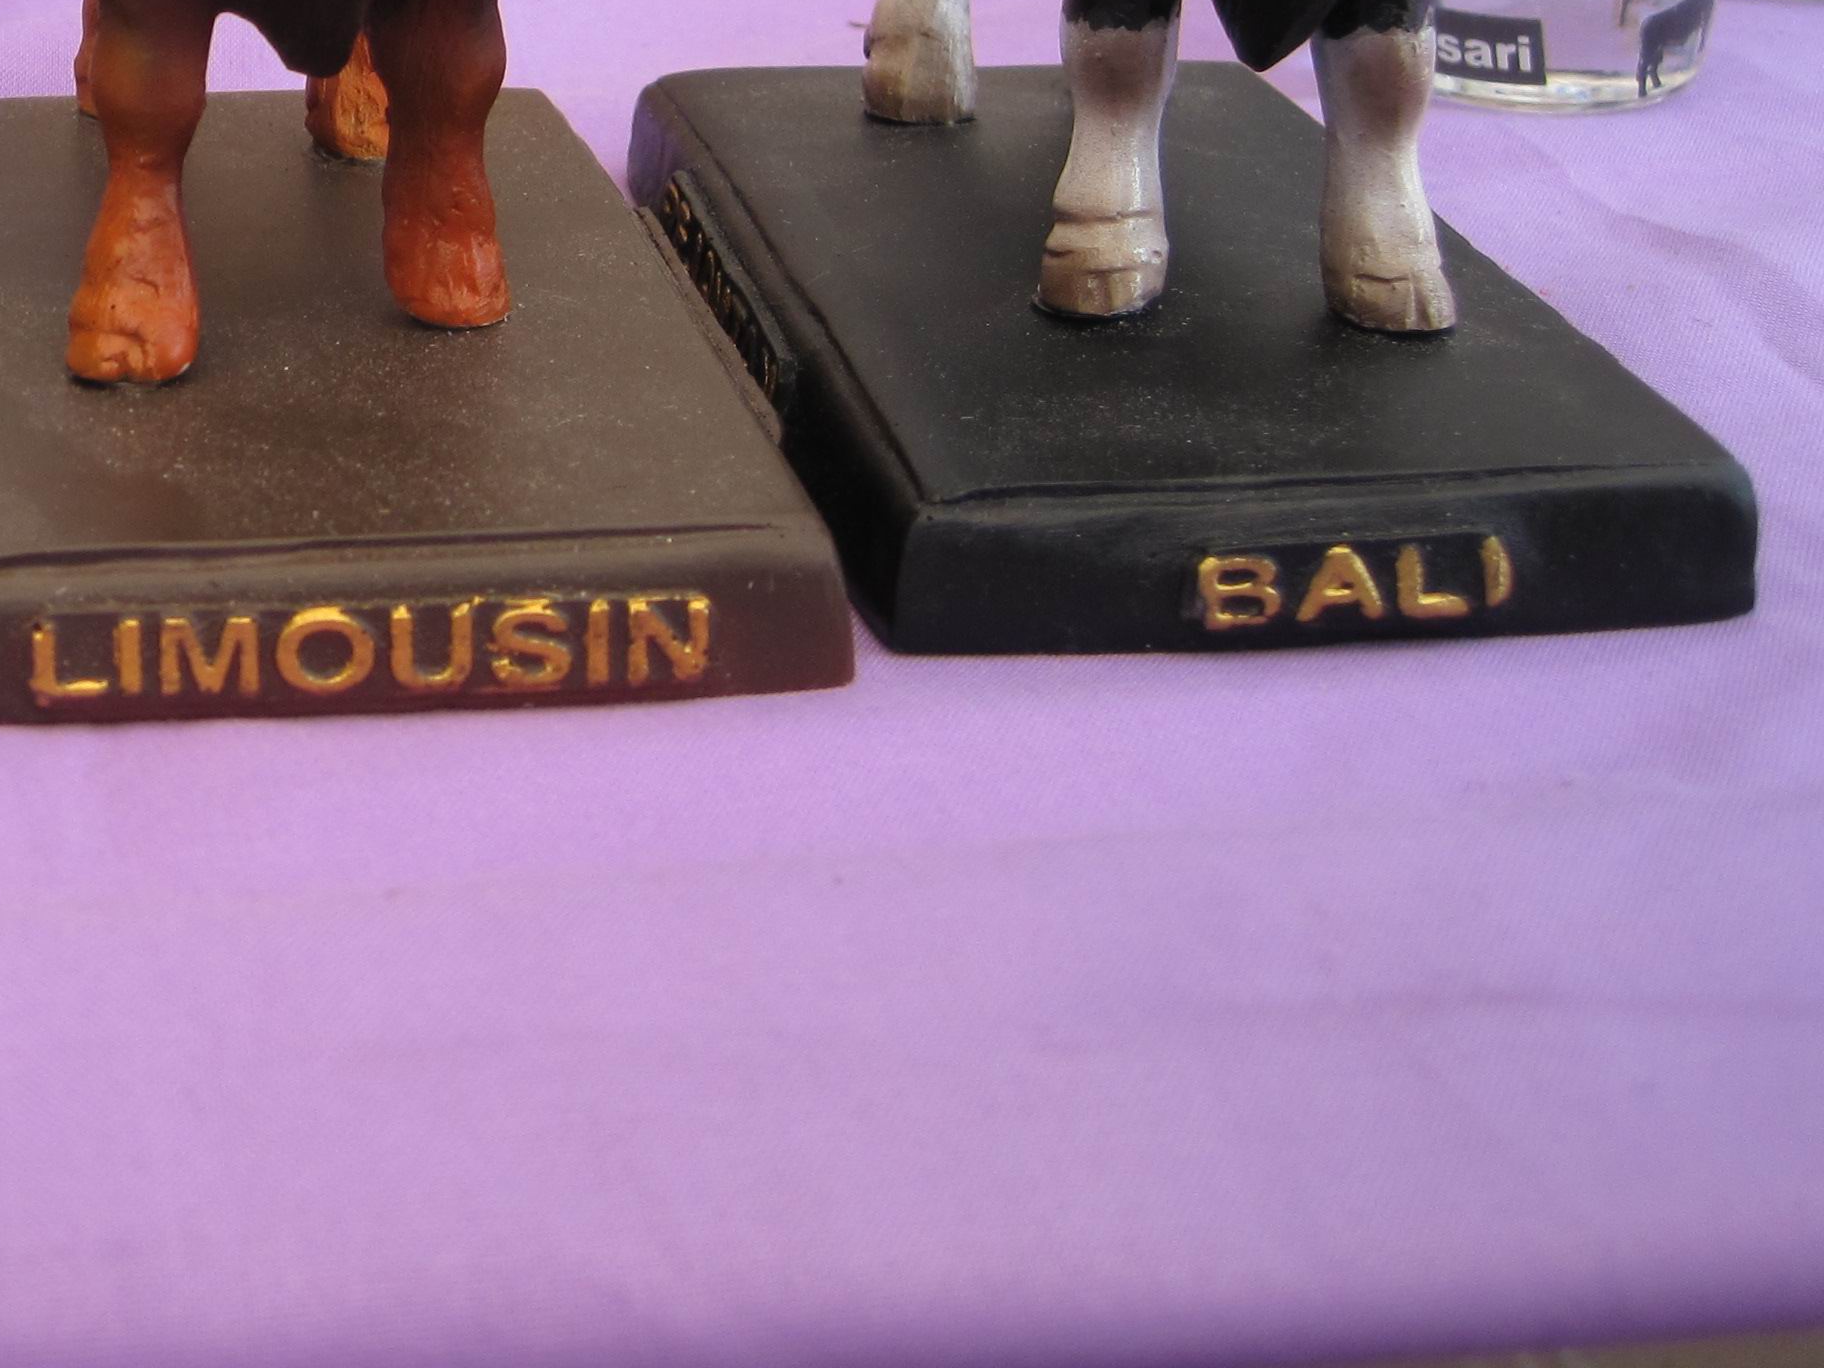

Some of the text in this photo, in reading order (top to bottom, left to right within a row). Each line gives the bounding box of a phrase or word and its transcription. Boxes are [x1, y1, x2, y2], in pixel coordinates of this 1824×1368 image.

[1436, 32, 1532, 73] sari
[1197, 535, 1515, 630] BALI
[30, 588, 711, 700] LIMOUSIN
